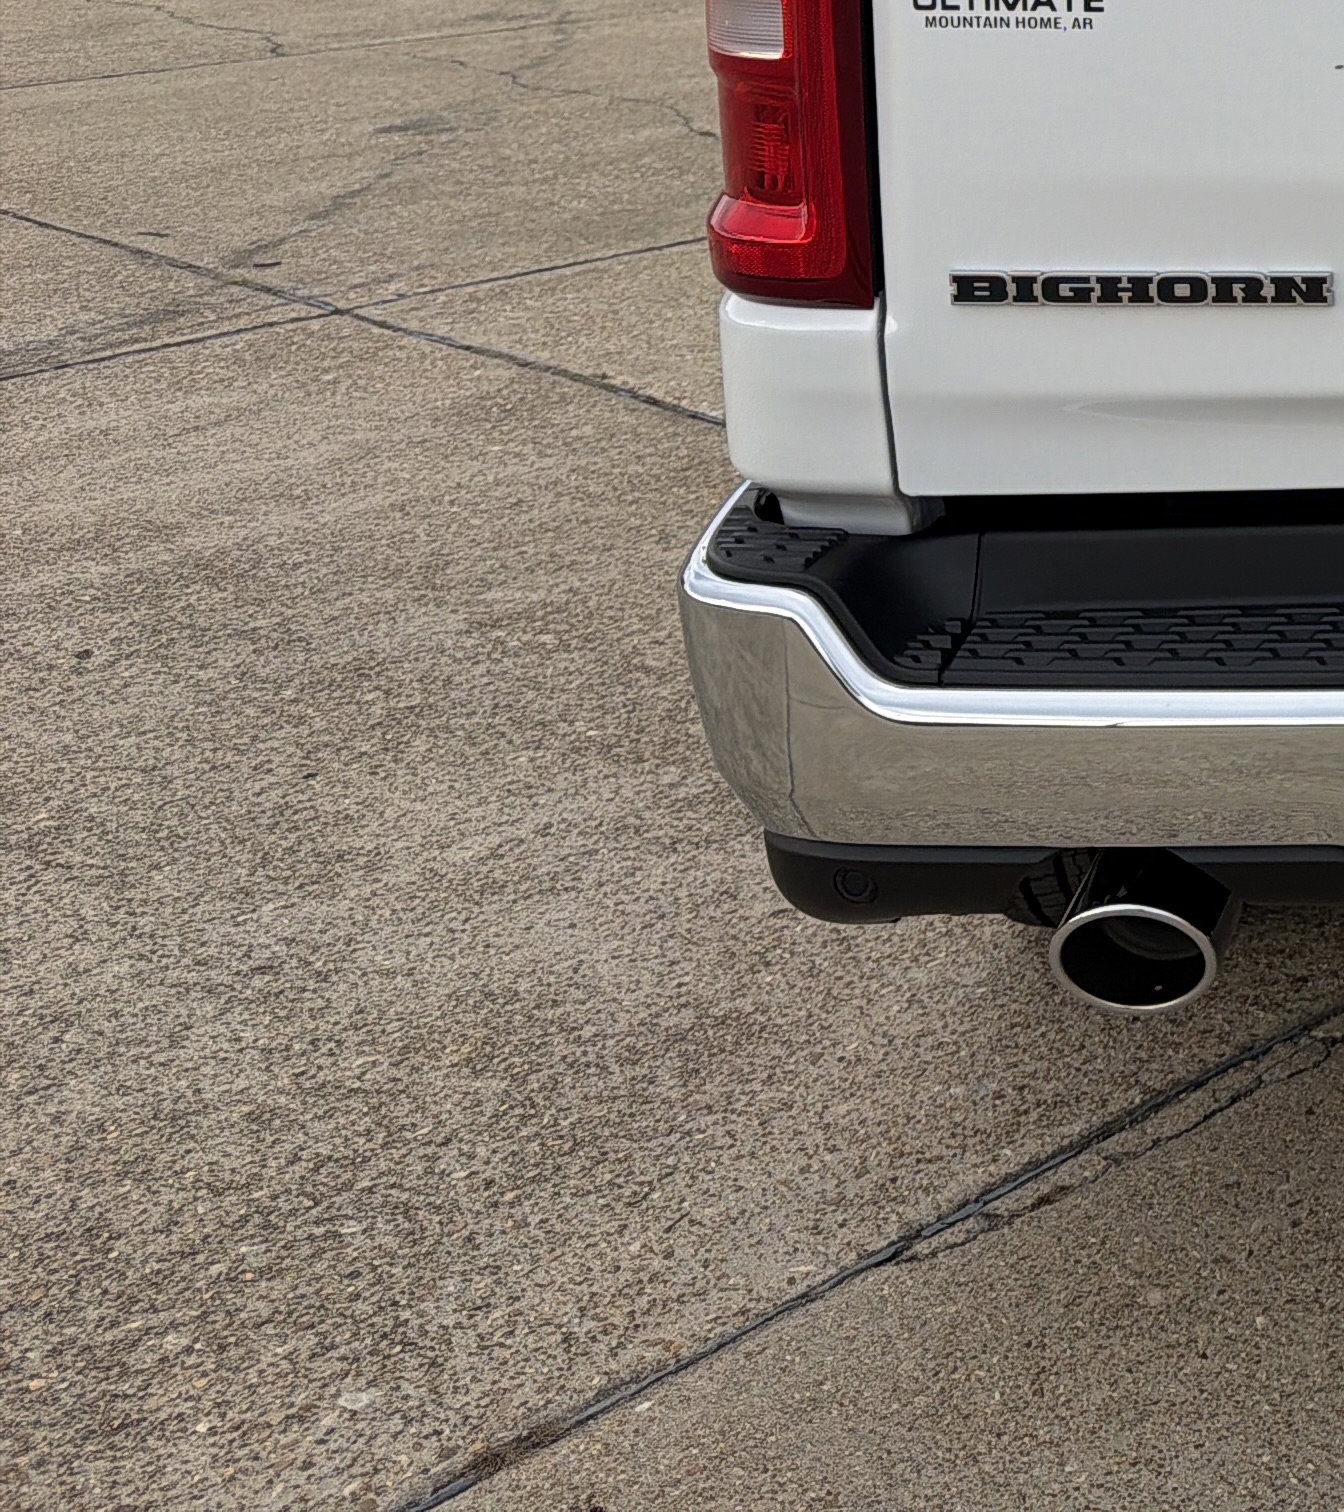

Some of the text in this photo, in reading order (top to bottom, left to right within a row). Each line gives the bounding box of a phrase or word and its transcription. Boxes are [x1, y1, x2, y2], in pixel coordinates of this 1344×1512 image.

[924, 15, 1094, 31] MOUNTAIN HOME, AR
[950, 270, 1335, 306] BIGHORN
